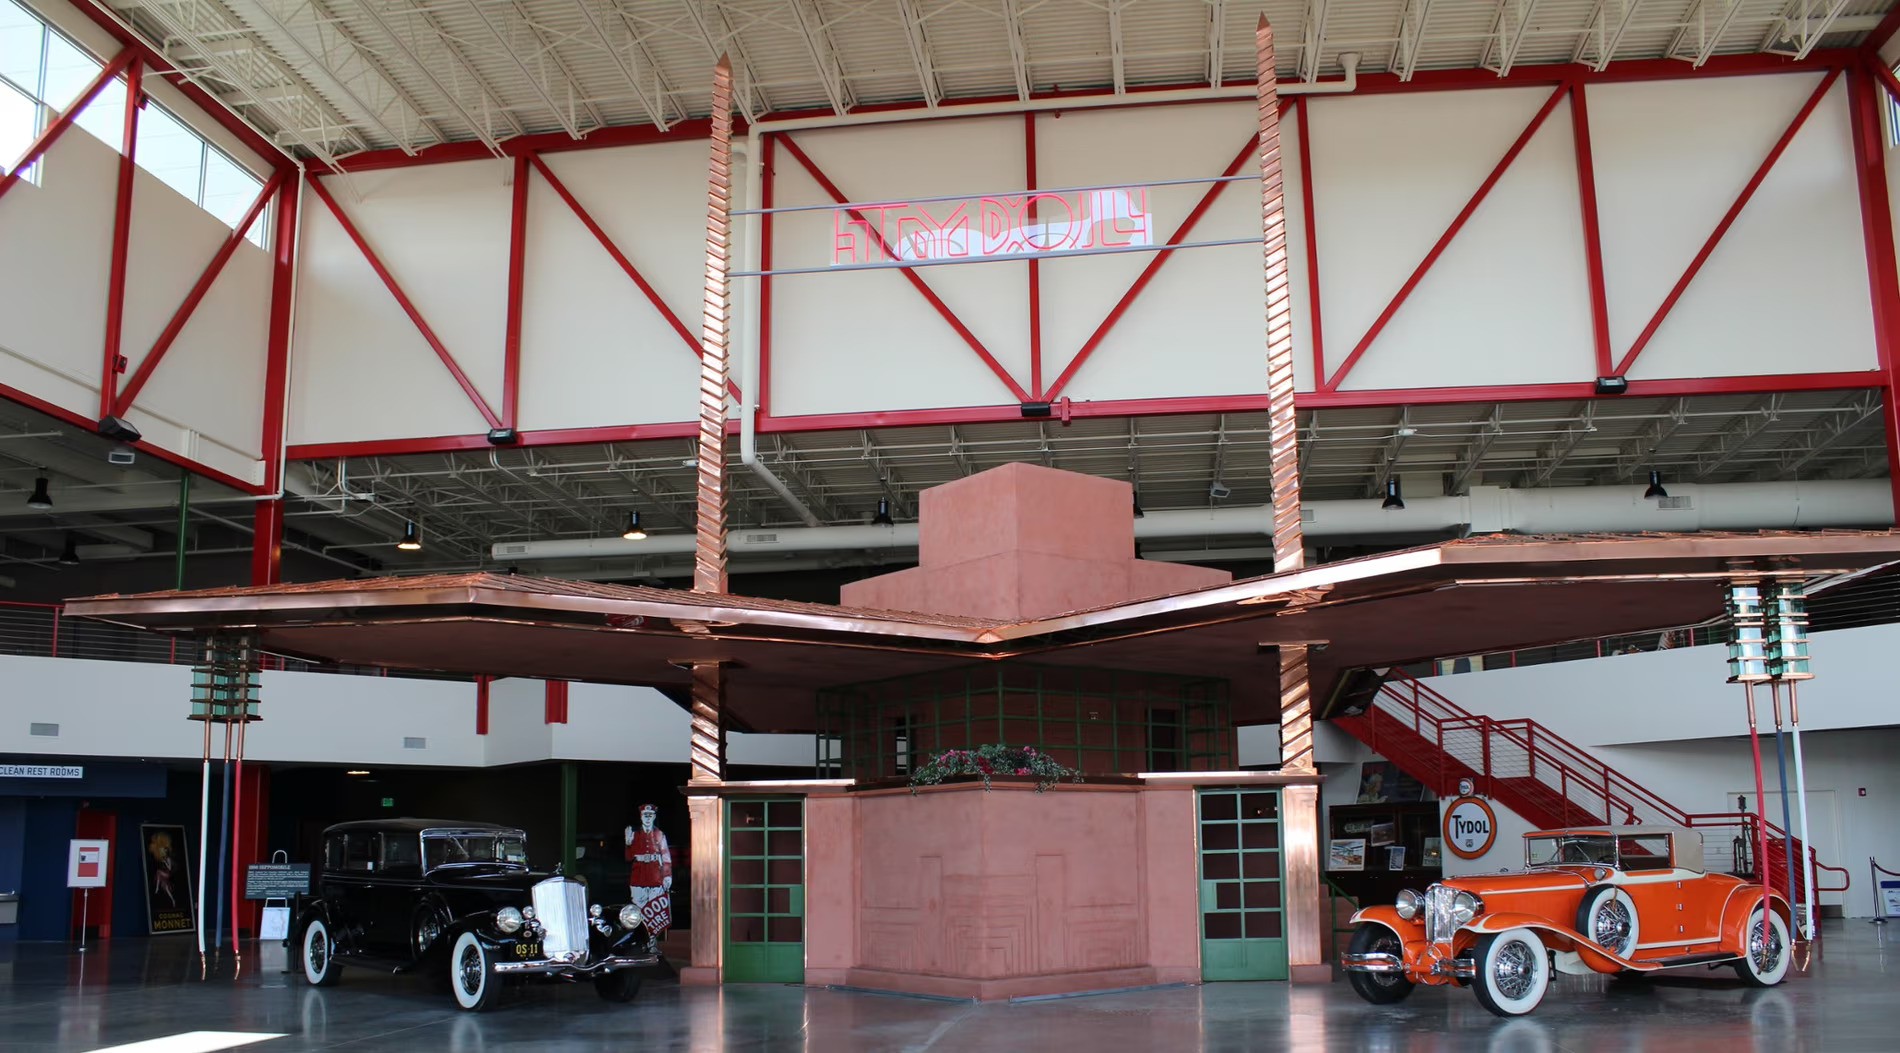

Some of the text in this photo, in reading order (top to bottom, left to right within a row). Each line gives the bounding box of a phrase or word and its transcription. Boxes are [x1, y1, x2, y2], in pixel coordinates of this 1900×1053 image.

[0, 766, 80, 777] CLEAN REST ROOMS
[153, 918, 191, 930] MONNET
[647, 910, 669, 929] TIRE
